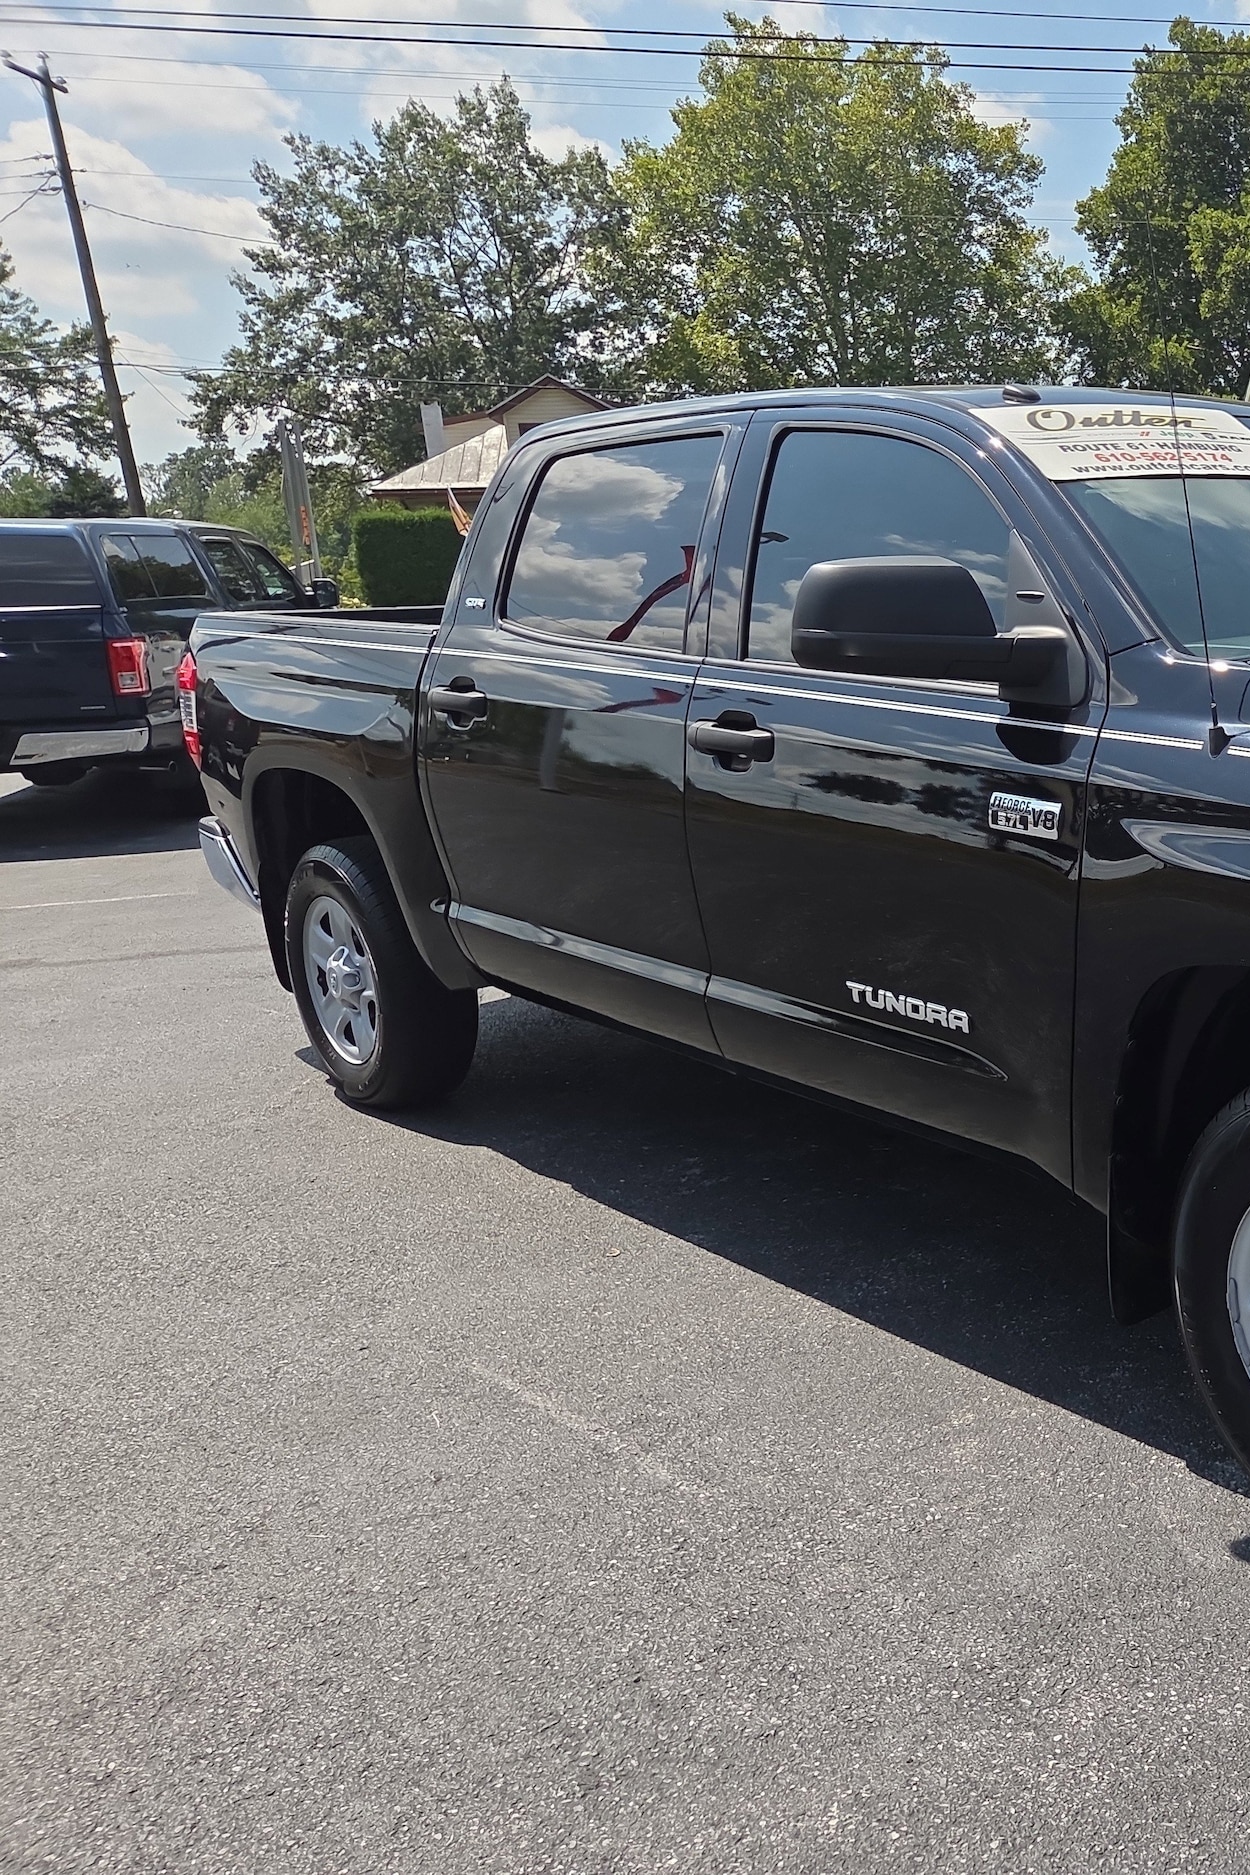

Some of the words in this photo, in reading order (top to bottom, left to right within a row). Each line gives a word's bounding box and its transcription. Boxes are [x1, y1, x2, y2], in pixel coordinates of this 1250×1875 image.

[1026, 409, 1217, 432] Outten
[1058, 442, 1125, 453] ROUTE
[1126, 442, 1149, 451] 61
[1155, 442, 1243, 453] HAMBURG
[1094, 452, 1233, 463] 610-562-5174
[845, 980, 970, 1034] TUNDRA
